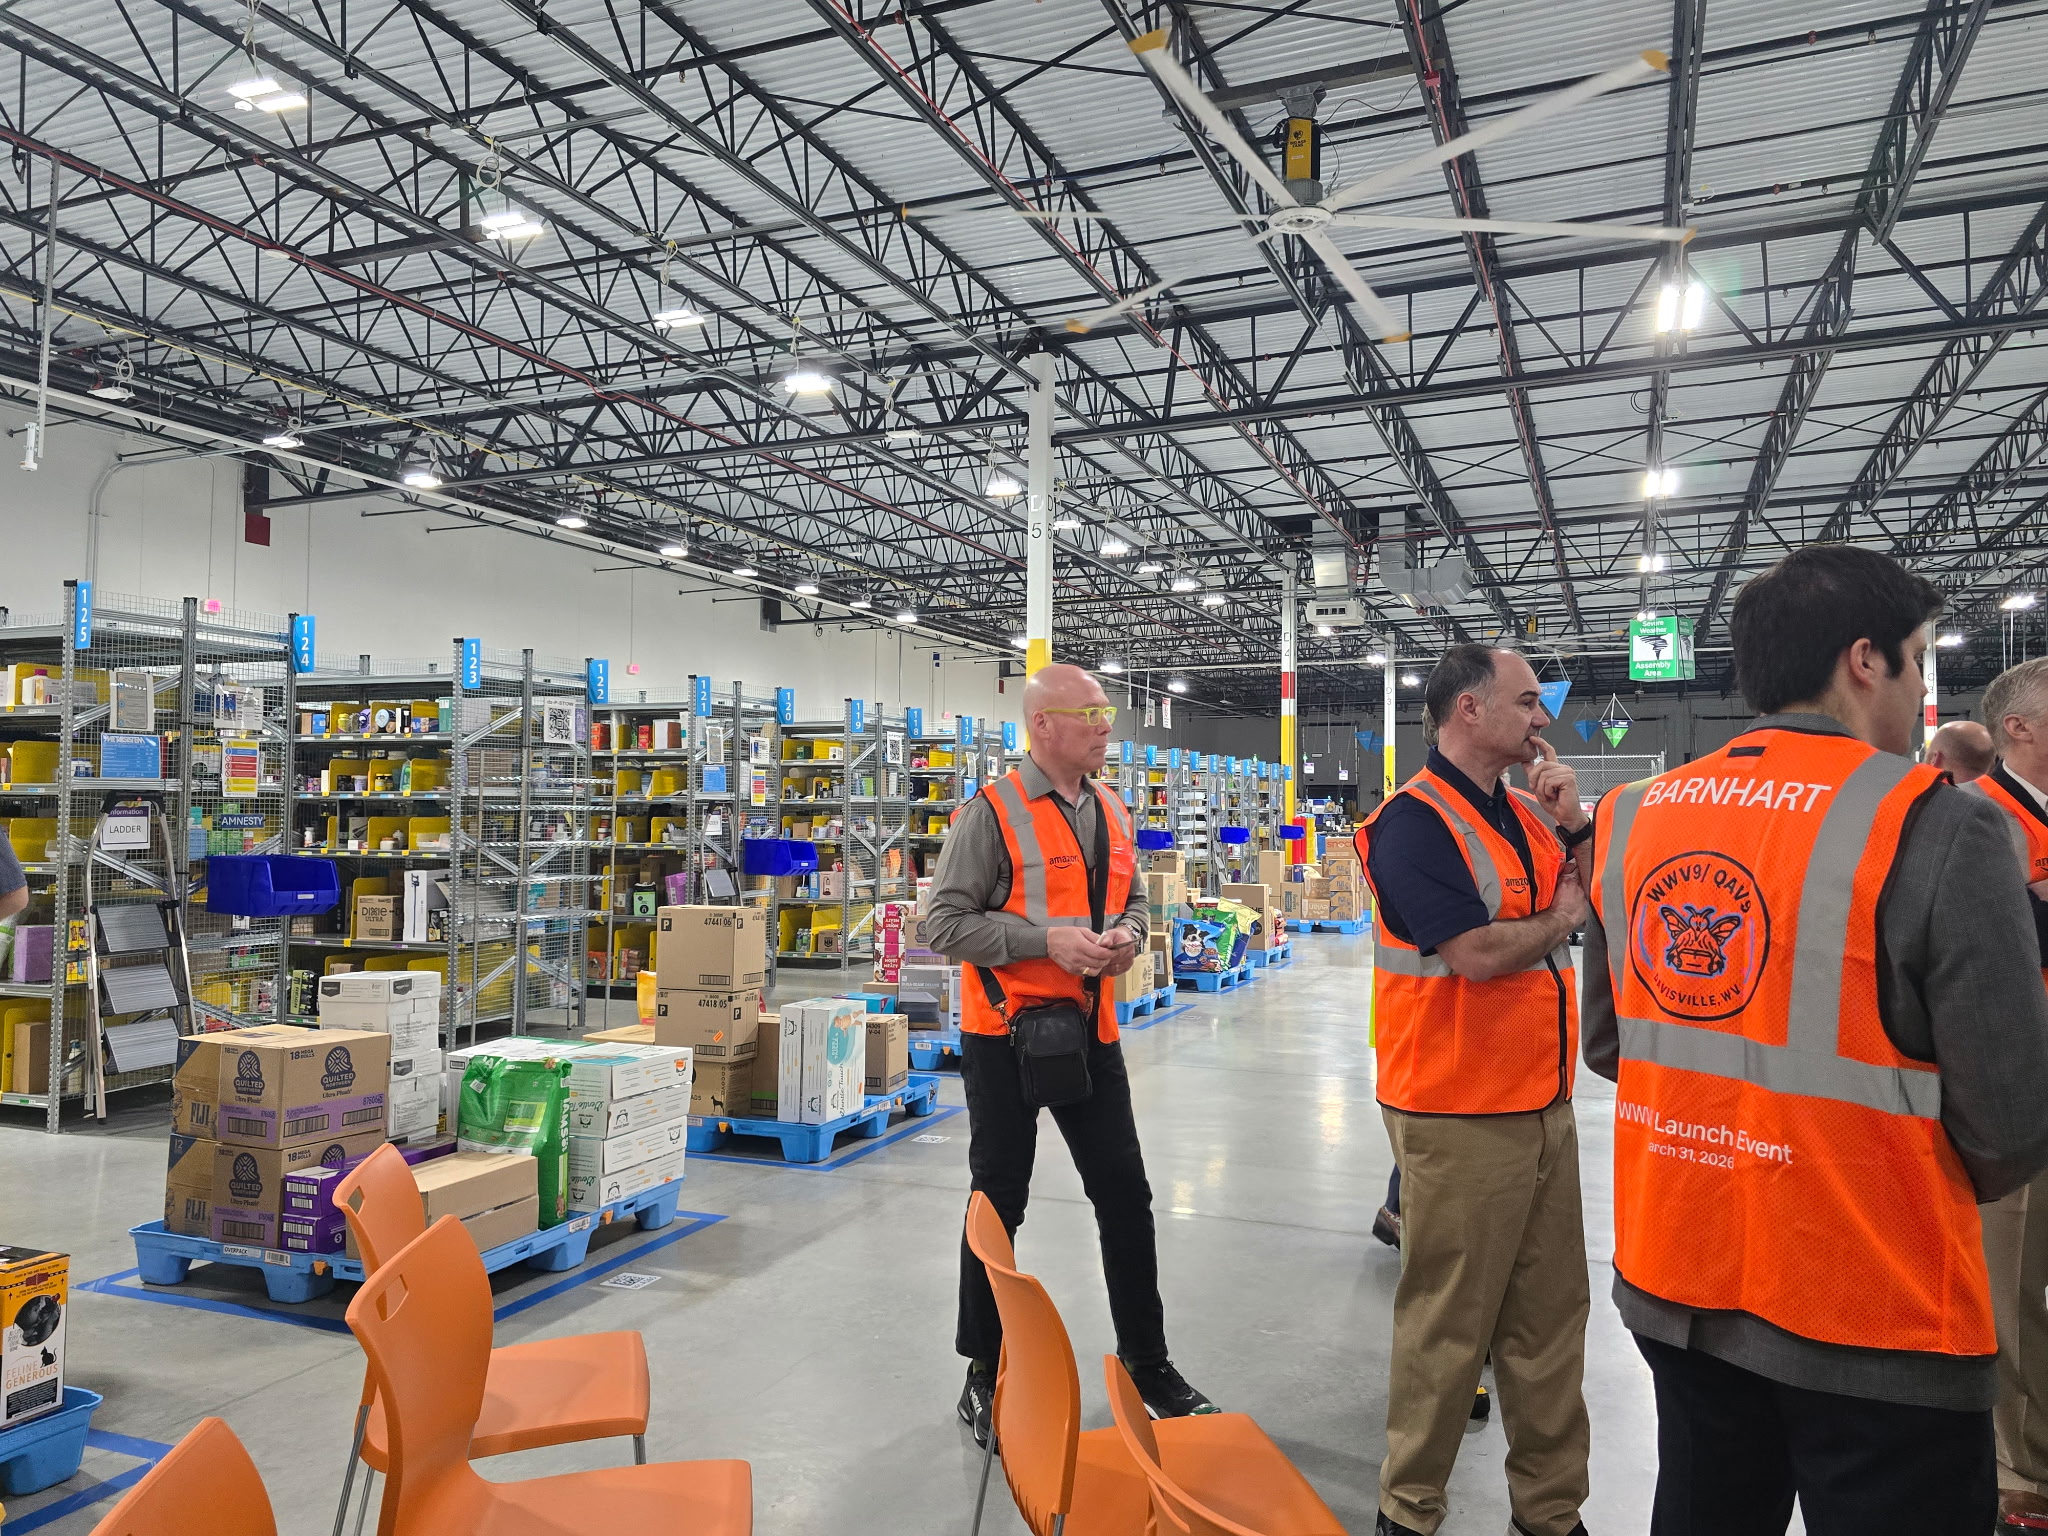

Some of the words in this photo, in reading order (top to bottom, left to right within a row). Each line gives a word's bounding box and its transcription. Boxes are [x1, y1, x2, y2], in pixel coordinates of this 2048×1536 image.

[80, 587, 88, 643] 125
[300, 620, 310, 668] 124
[469, 642, 478, 684] 123
[1635, 661, 1672, 670] Assembly
[596, 664, 605, 700] 122
[1643, 778, 1832, 813] BARNHART
[110, 808, 144, 816] nformation
[221, 816, 264, 827] AMNESTY
[109, 824, 142, 834] LADDER
[1049, 854, 1079, 866] amazon
[1506, 878, 1530, 888] amazo
[1714, 869, 1752, 914] QAV9
[704, 918, 722, 926] 47441
[724, 918, 732, 926] 06
[698, 1000, 718, 1008] 47418
[719, 1000, 728, 1008] 05
[181, 1041, 190, 1052] 12
[290, 1050, 300, 1060] 18
[322, 1072, 354, 1083] QUILTED
[236, 1080, 264, 1089] QUILTED
[190, 1102, 210, 1126] FIJI
[1617, 1100, 1653, 1126] WWV
[1654, 1112, 1734, 1146] Launch
[1736, 1129, 1794, 1164] Event
[174, 1140, 182, 1150] 12
[288, 1152, 298, 1162] 18
[1648, 1142, 1676, 1158] arch
[1678, 1146, 1696, 1164] 31,
[1700, 1151, 1735, 1170] 2026
[230, 1182, 262, 1191] QUILTED
[184, 1198, 206, 1220] FIJI
[224, 1246, 248, 1254] OVERPACK
[6, 1360, 38, 1380] FELINE
[6, 1364, 58, 1390] GENEROUS
